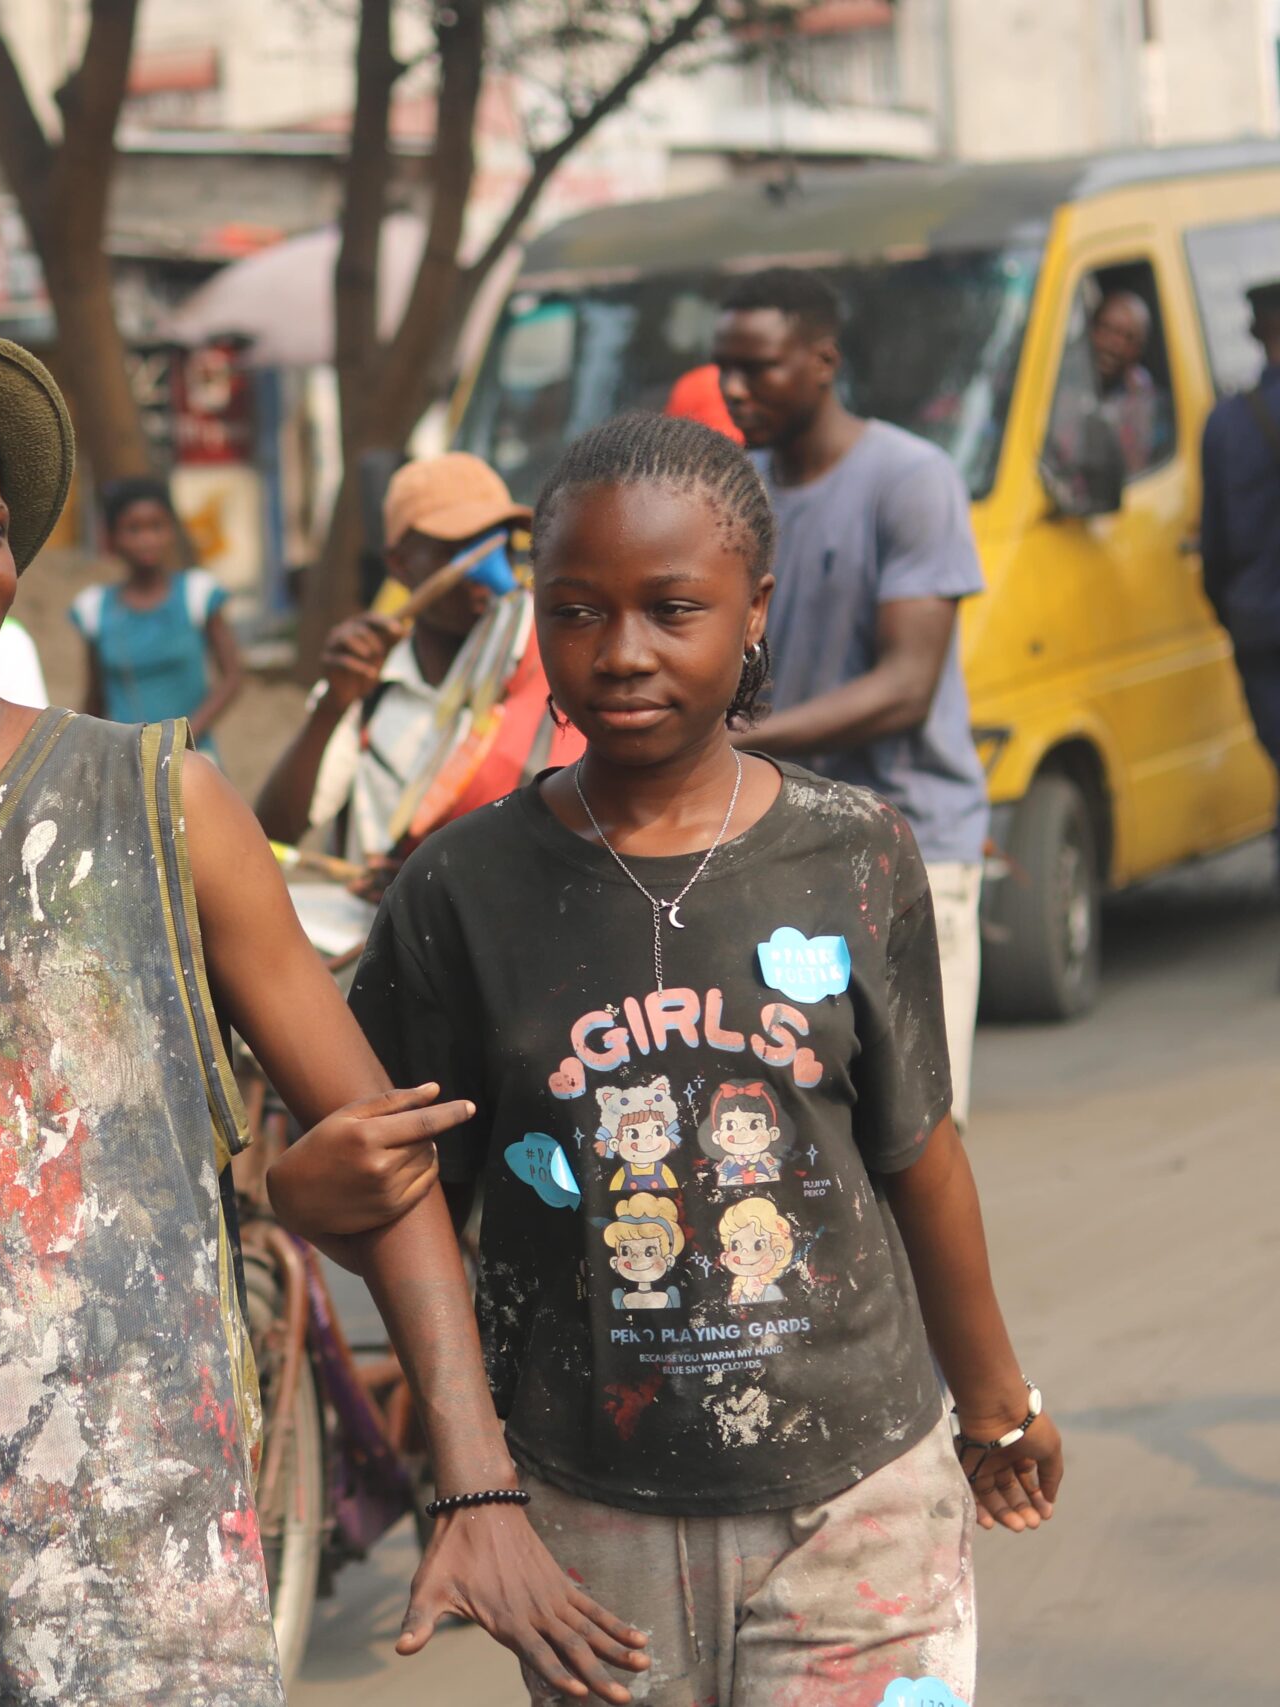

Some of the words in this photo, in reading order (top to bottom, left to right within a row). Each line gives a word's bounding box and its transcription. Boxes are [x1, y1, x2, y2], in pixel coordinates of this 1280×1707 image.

[570, 987, 810, 1072] GIRLS
[803, 1179, 832, 1189] FUJIYA
[803, 1188, 826, 1198] PEKO
[661, 1323, 741, 1343] PLAYING
[748, 1316, 811, 1337] GARDS
[639, 1352, 677, 1363] BECAUSE
[678, 1351, 699, 1363] YOU
[701, 1349, 735, 1361] WARM
[737, 1347, 752, 1359] MY
[754, 1344, 783, 1357] HAND
[662, 1365, 684, 1375] BLUE
[684, 1363, 704, 1374] SKY
[705, 1363, 721, 1373] TO
[721, 1360, 762, 1372] CLOUDS
